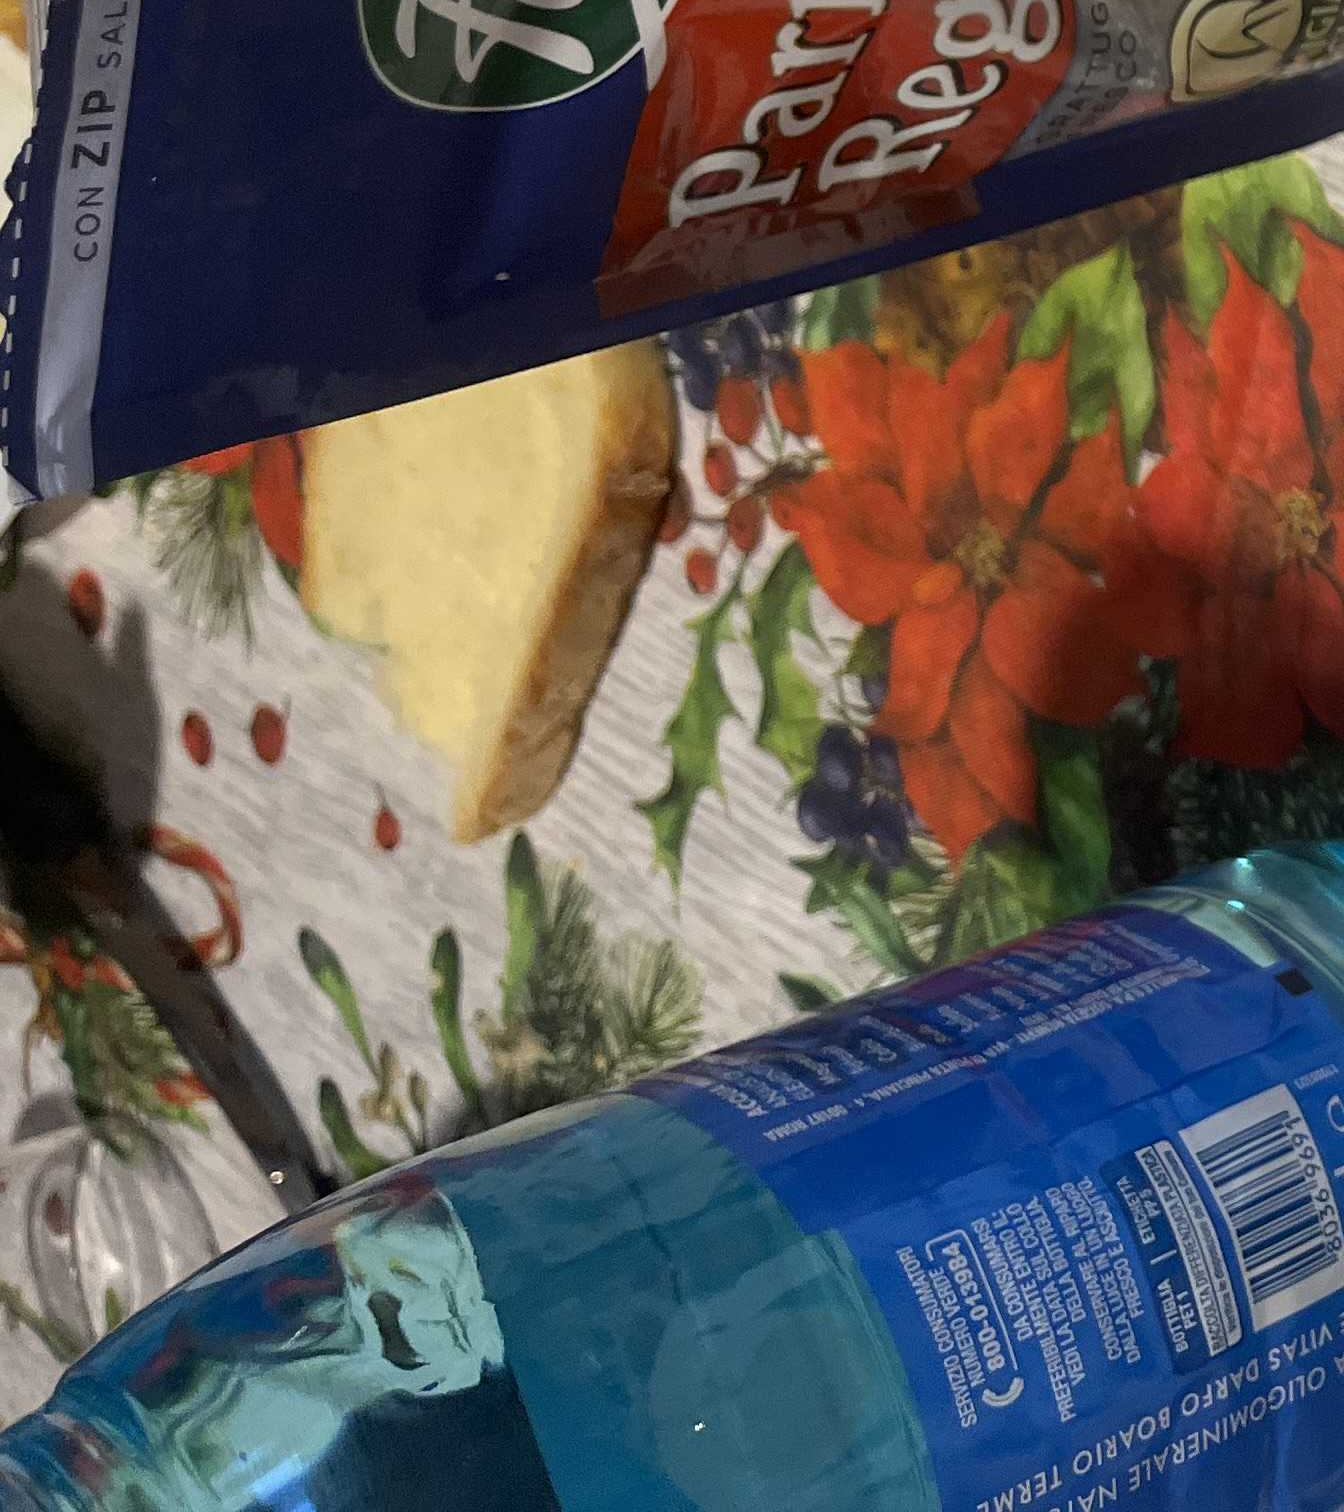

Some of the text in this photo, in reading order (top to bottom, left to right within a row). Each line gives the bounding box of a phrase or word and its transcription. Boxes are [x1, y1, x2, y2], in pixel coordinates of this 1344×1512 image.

[70, 89, 116, 169] ZIP
[73, 187, 105, 263] CON
[1285, 1115, 1321, 1178] 9691
[1107, 1242, 1125, 1254] E
[1116, 1175, 1156, 1245] ETICHETTA
[1313, 1188, 1342, 1253] 8036
[972, 1217, 1034, 1341] DA CONSUMARSI
[998, 1229, 1030, 1277] ENTRO
[1027, 1195, 1086, 1322] DELLA BOTTIGLIA.
[1045, 1186, 1123, 1360] CONSERVARE AL RIPARO
[1061, 1181, 1142, 1364] DALLA LUCE IN UN LUOGO
[1116, 1257, 1145, 1319] FRESCO
[1140, 1150, 1226, 1350] RACCOLTA DIFFERENZIATA PLASTICA
[929, 1266, 986, 1387] NUMERO VERDE
[941, 1241, 1006, 1371] 800-013984
[1007, 1202, 1086, 1386] VEDI LA DATA SUL COLLO
[1157, 1277, 1190, 1352] BOTTIGLIA
[1180, 1301, 1199, 1329] PET
[896, 1246, 978, 1428] SERVIZIO CONSUMATORI
[1022, 1279, 1077, 1422] PREFERIBILMENTE
[1267, 1326, 1334, 1376] VITAS
[1181, 1365, 1263, 1419] DARFO
[1073, 1398, 1173, 1476] BOARIO
[1128, 1371, 1329, 1496] OLIGOMINERALE
